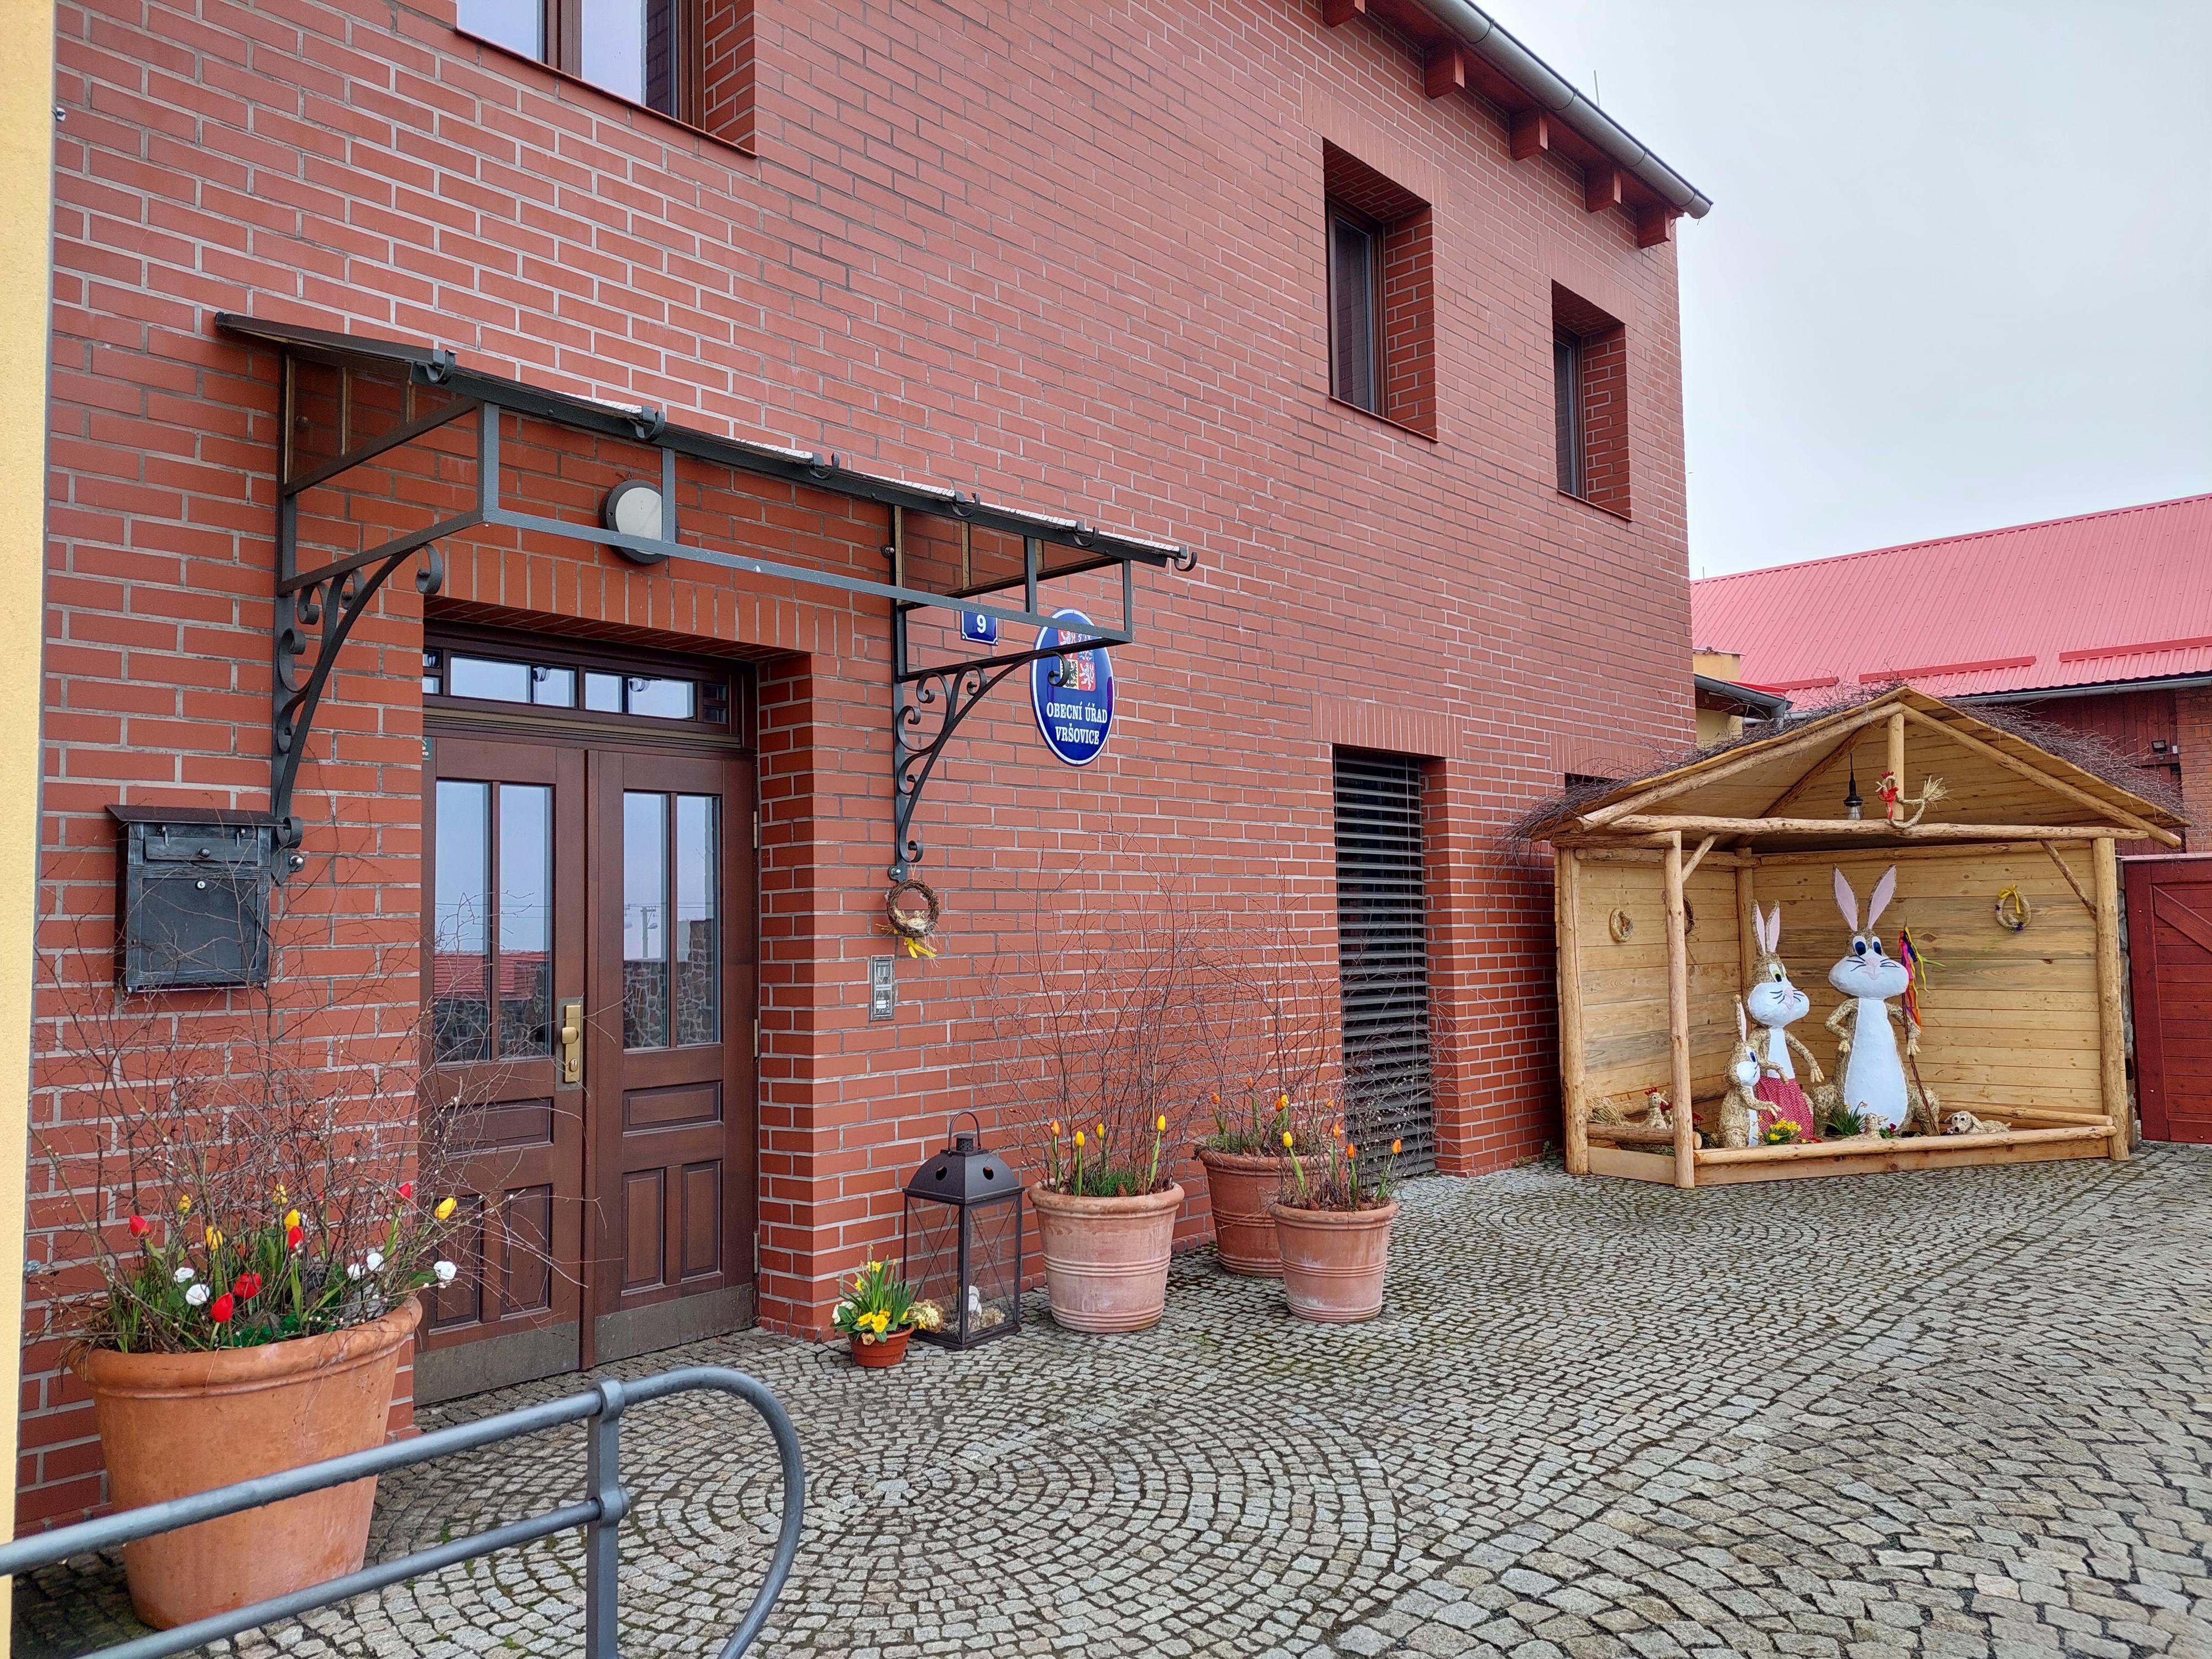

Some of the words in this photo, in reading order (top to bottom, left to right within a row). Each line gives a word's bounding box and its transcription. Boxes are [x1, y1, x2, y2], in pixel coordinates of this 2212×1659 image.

[977, 614, 987, 634] 9
[1046, 701, 1083, 721] OBECNÍ
[1084, 702, 1108, 724] ÚŘAD
[1055, 722, 1100, 745] VRŠOVICE
